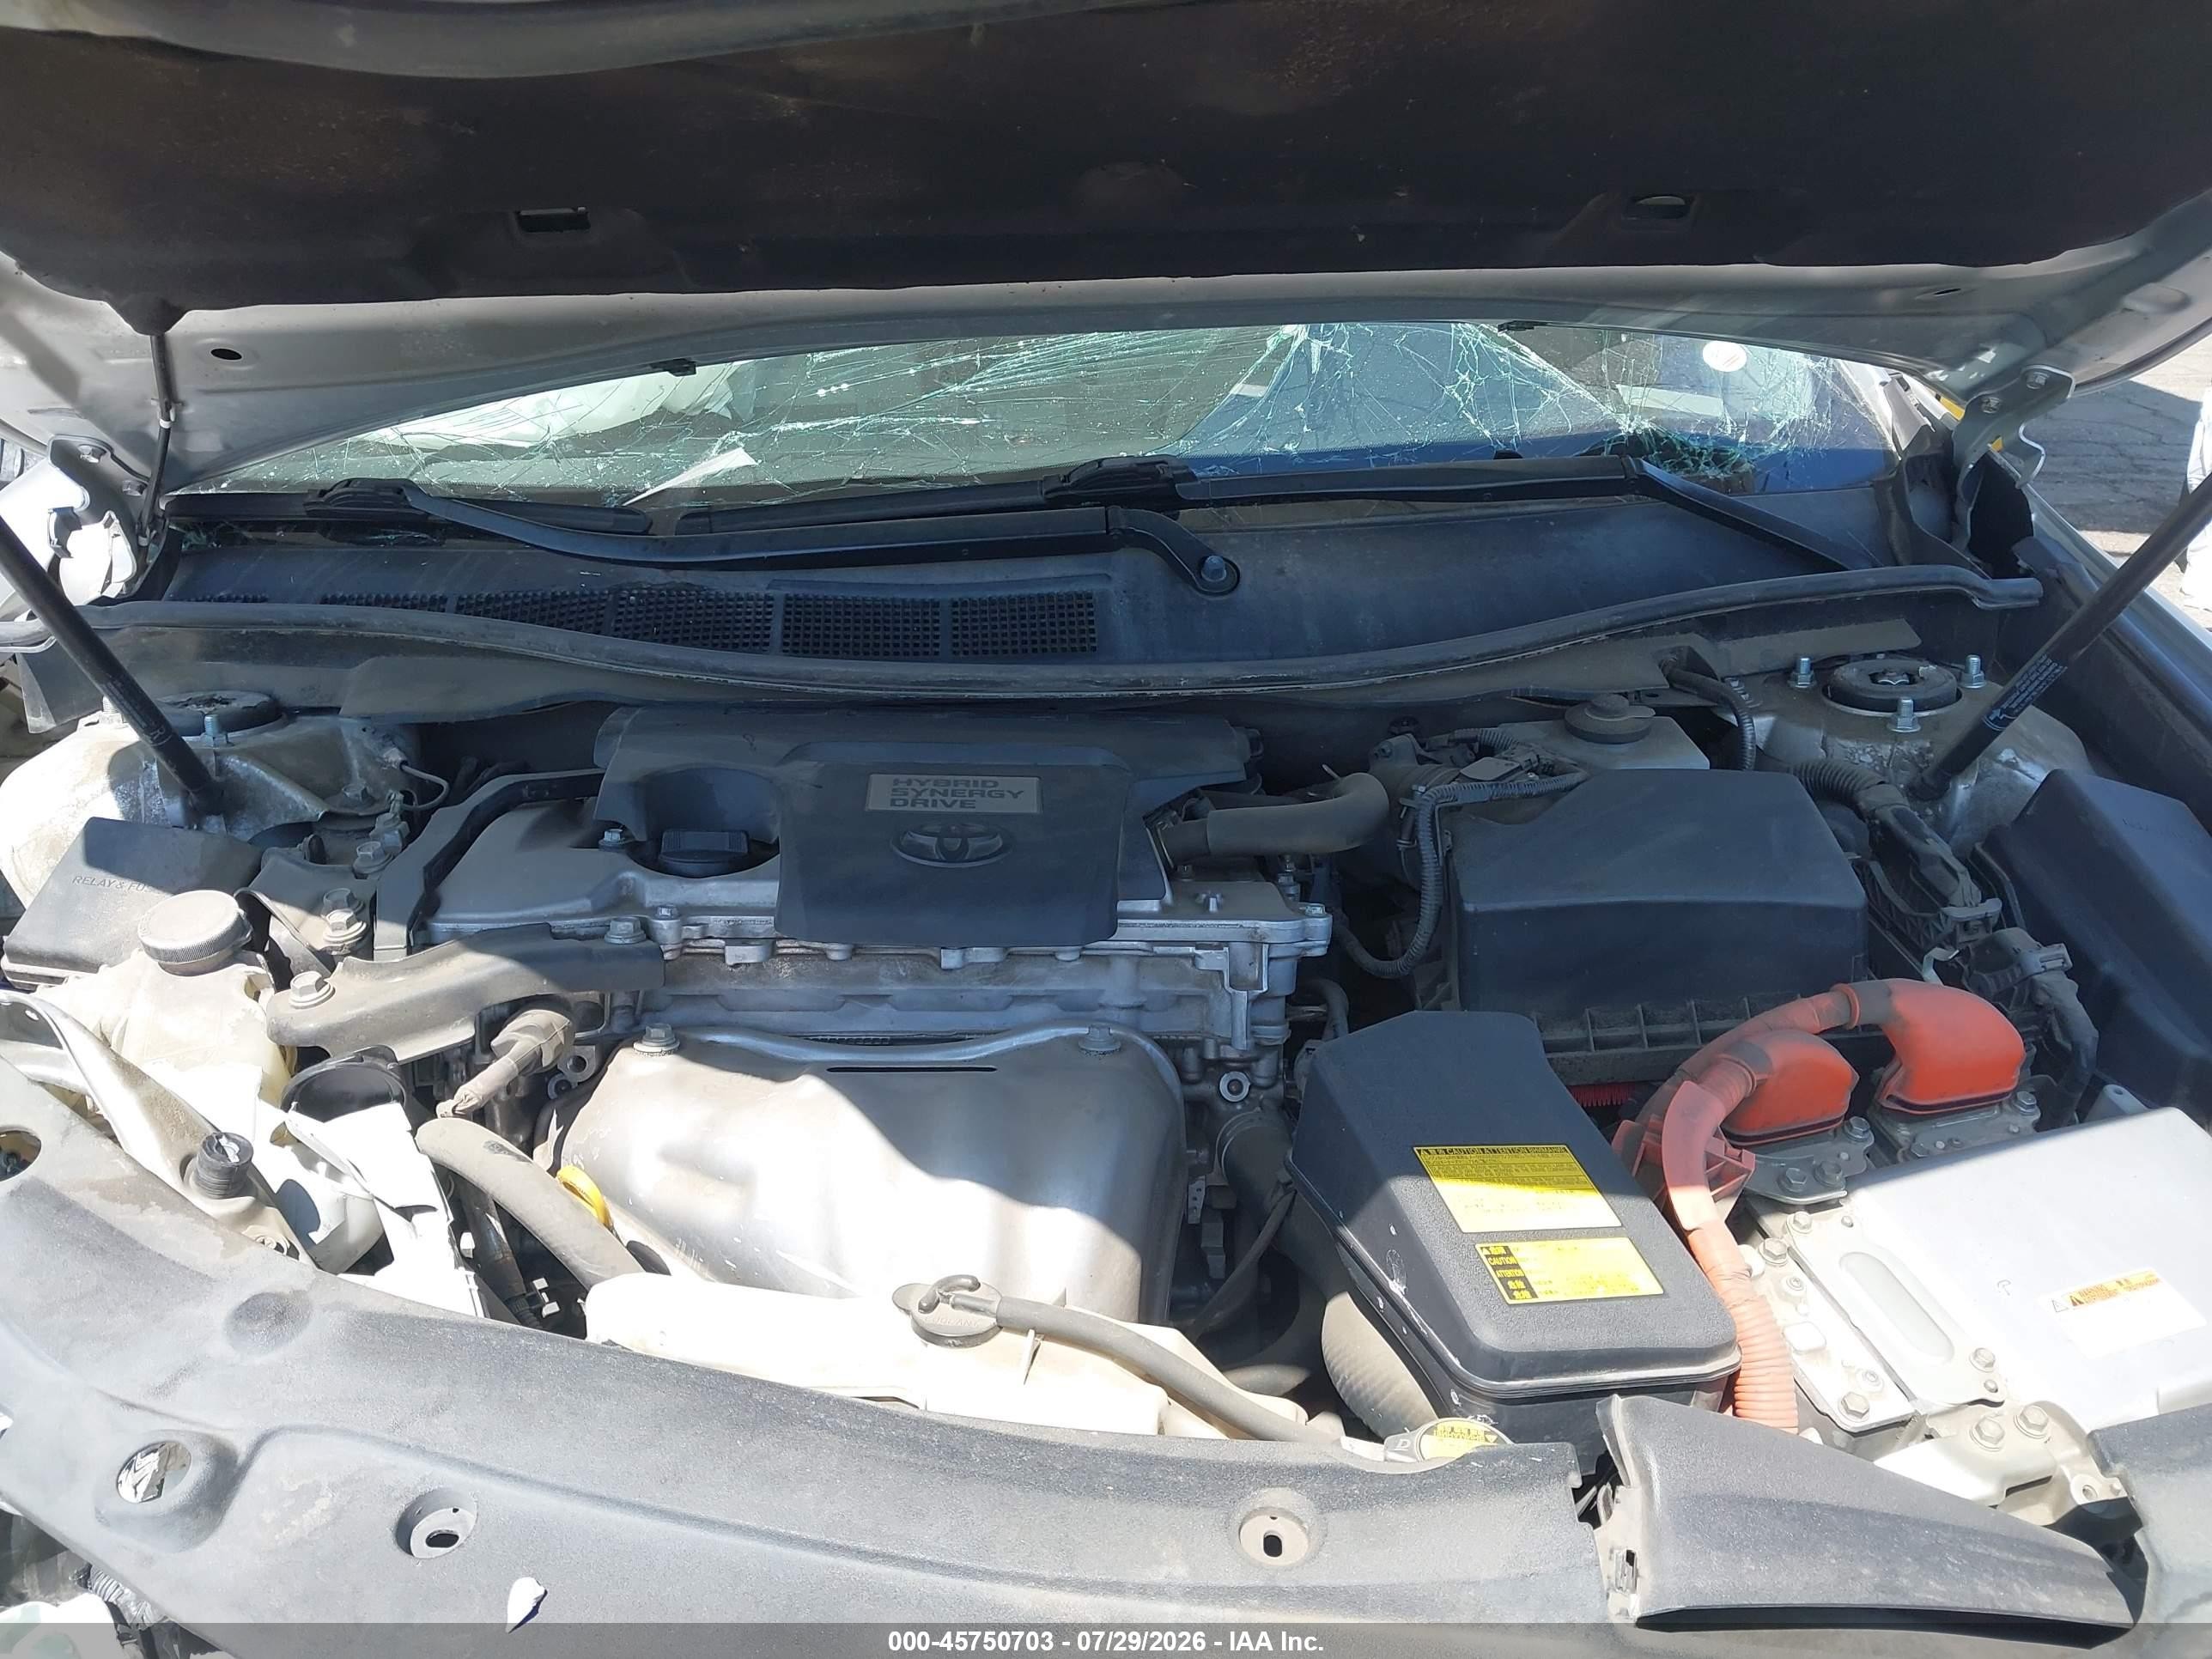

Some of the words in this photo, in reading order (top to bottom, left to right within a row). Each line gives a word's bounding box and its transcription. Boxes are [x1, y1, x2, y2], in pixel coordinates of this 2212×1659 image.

[893, 778, 999, 788] HYBRID
[890, 787, 1024, 799] SYNERGY
[890, 799, 976, 809] DRIVE
[72, 875, 116, 888] RELAY
[1484, 1146, 1528, 1155] ATTENTION
[1488, 1255, 1518, 1266] CAUTION
